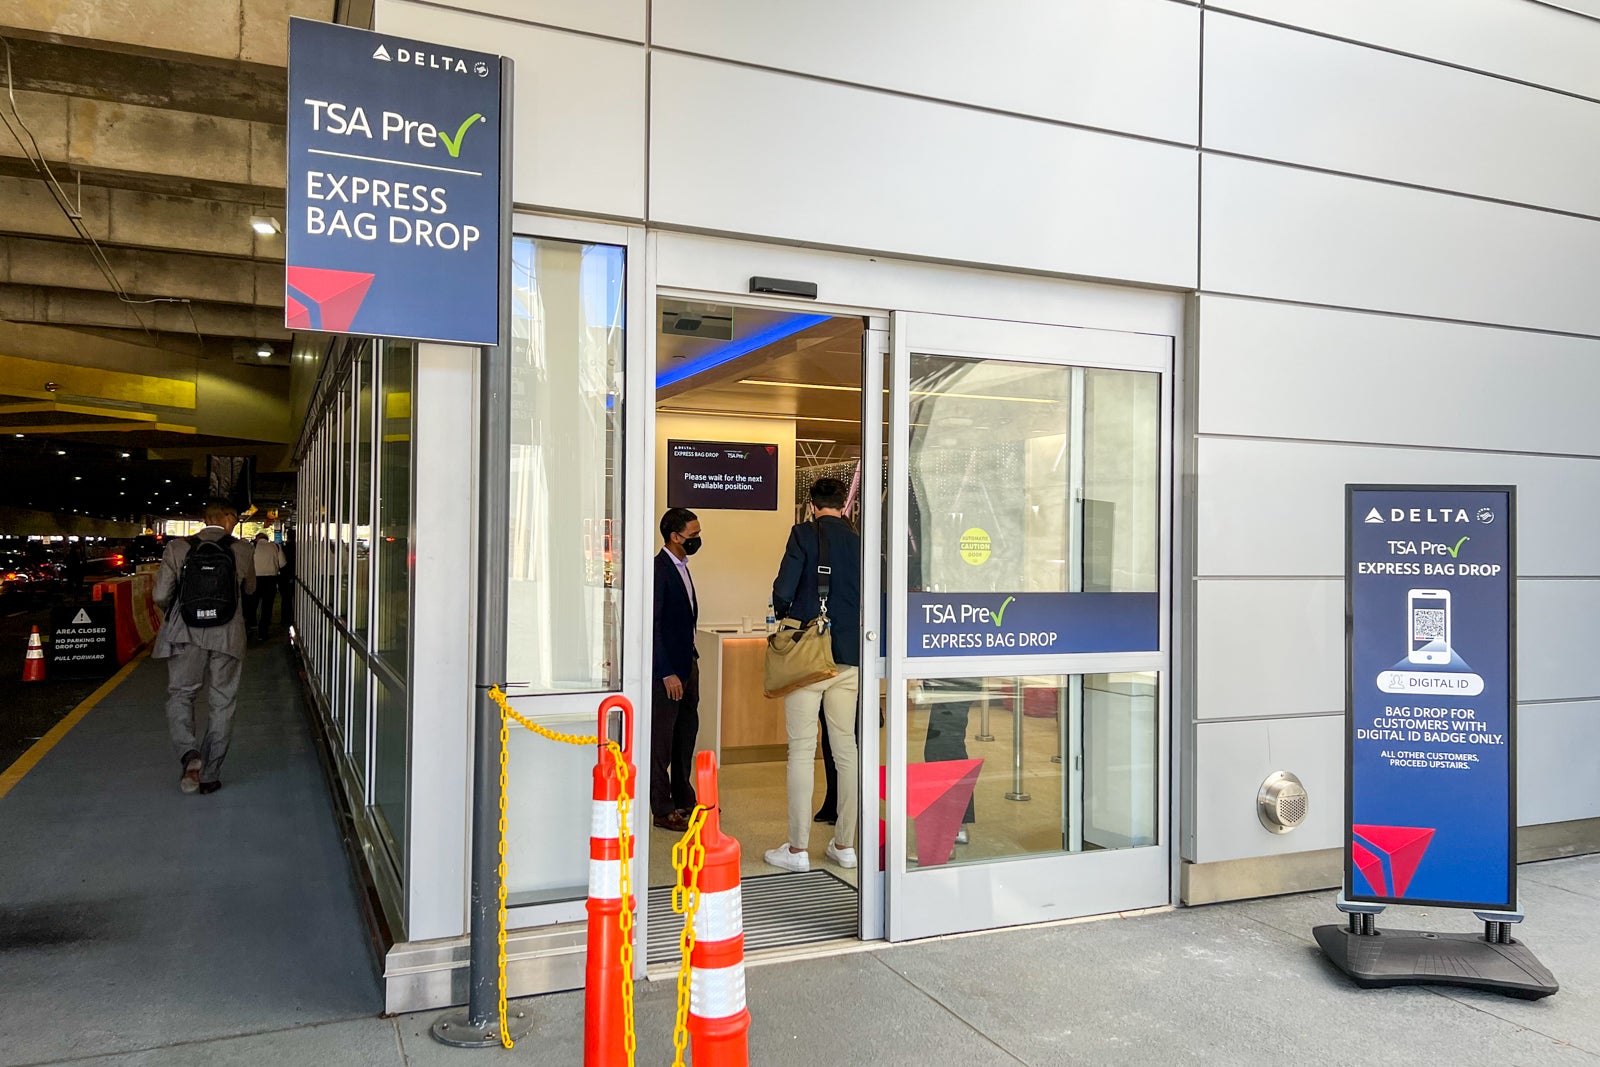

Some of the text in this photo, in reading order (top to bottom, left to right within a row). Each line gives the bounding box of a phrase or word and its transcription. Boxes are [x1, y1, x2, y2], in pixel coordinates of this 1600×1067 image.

[397, 48, 468, 74] DELTA
[304, 98, 372, 139] TSA
[307, 170, 447, 214] EXPRESS
[307, 206, 480, 250] BAG DROP
[724, 474, 734, 482] for
[736, 474, 747, 482] the
[693, 482, 754, 491] available position.
[1391, 508, 1470, 523] DELTA
[1387, 541, 1417, 555] TSA
[1358, 562, 1501, 576] EXPRESS BAG DROP
[922, 604, 956, 624] TSA
[922, 632, 1058, 649] EXPRESS BAG DROP
[1409, 677, 1469, 689] DIGITAL ID
[1385, 707, 1475, 720] BAG DROP FOR
[1373, 718, 1486, 732] CUSTOMERS WITH
[1357, 730, 1504, 745] DIGITAL ID BADGE ONLY.
[1397, 751, 1424, 760] OTHER
[1390, 759, 1471, 770] PROCEED UPSTAIRS.
